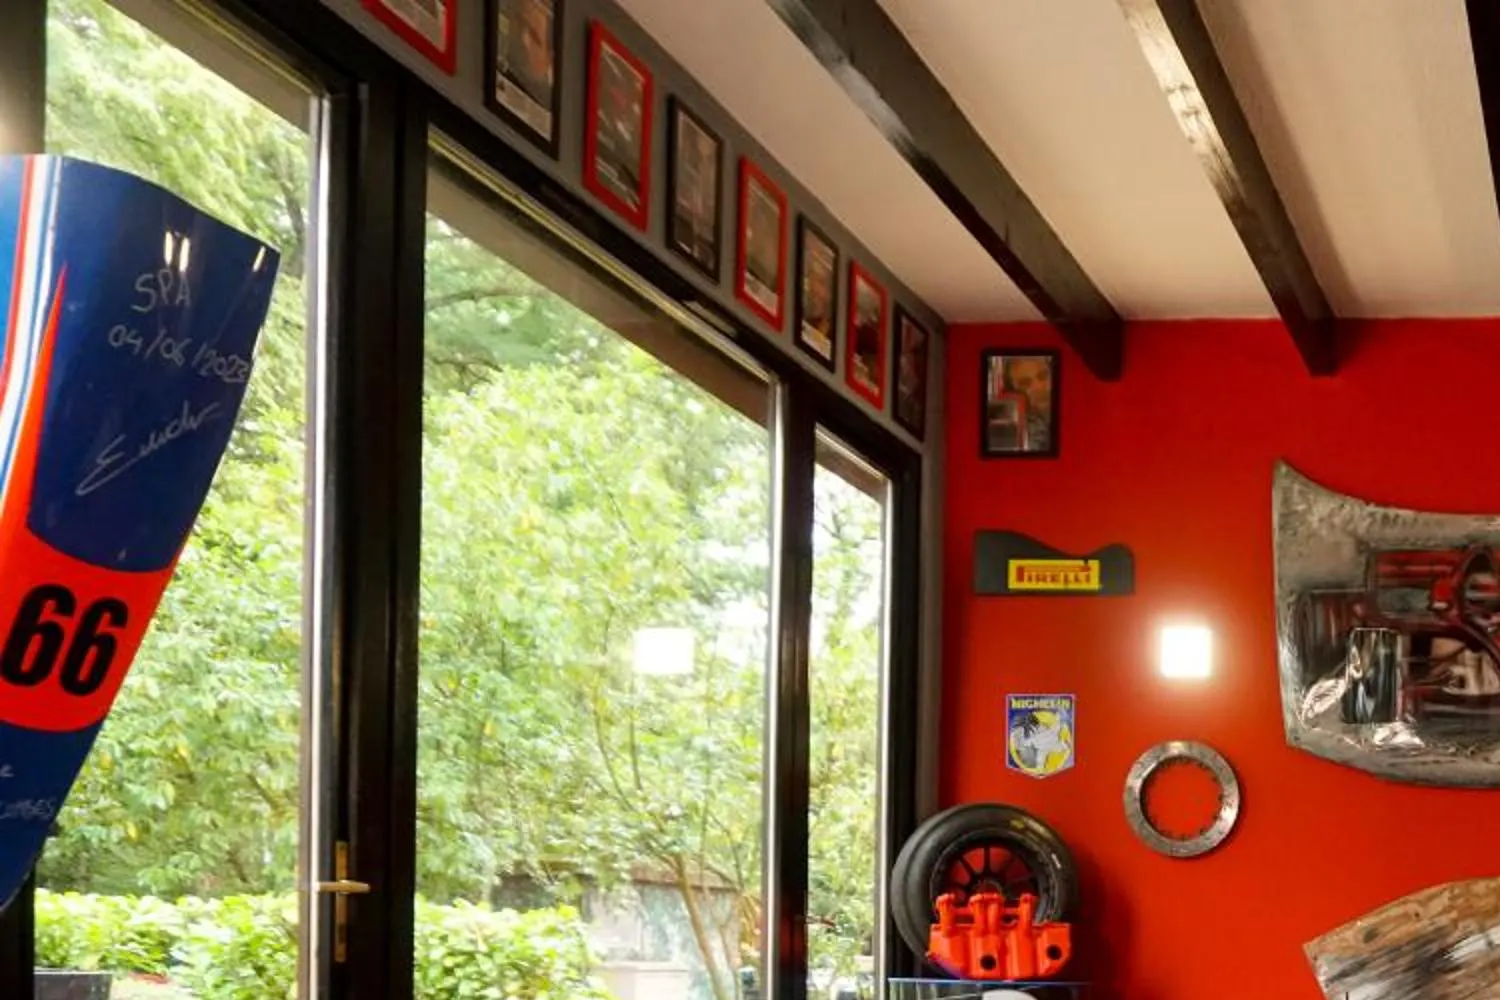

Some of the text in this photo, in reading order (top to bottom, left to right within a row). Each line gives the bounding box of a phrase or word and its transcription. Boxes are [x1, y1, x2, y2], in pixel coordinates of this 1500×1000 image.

[131, 268, 191, 312] SPA
[1015, 565, 1091, 584] PIRELLI
[0, 583, 130, 697] 66
